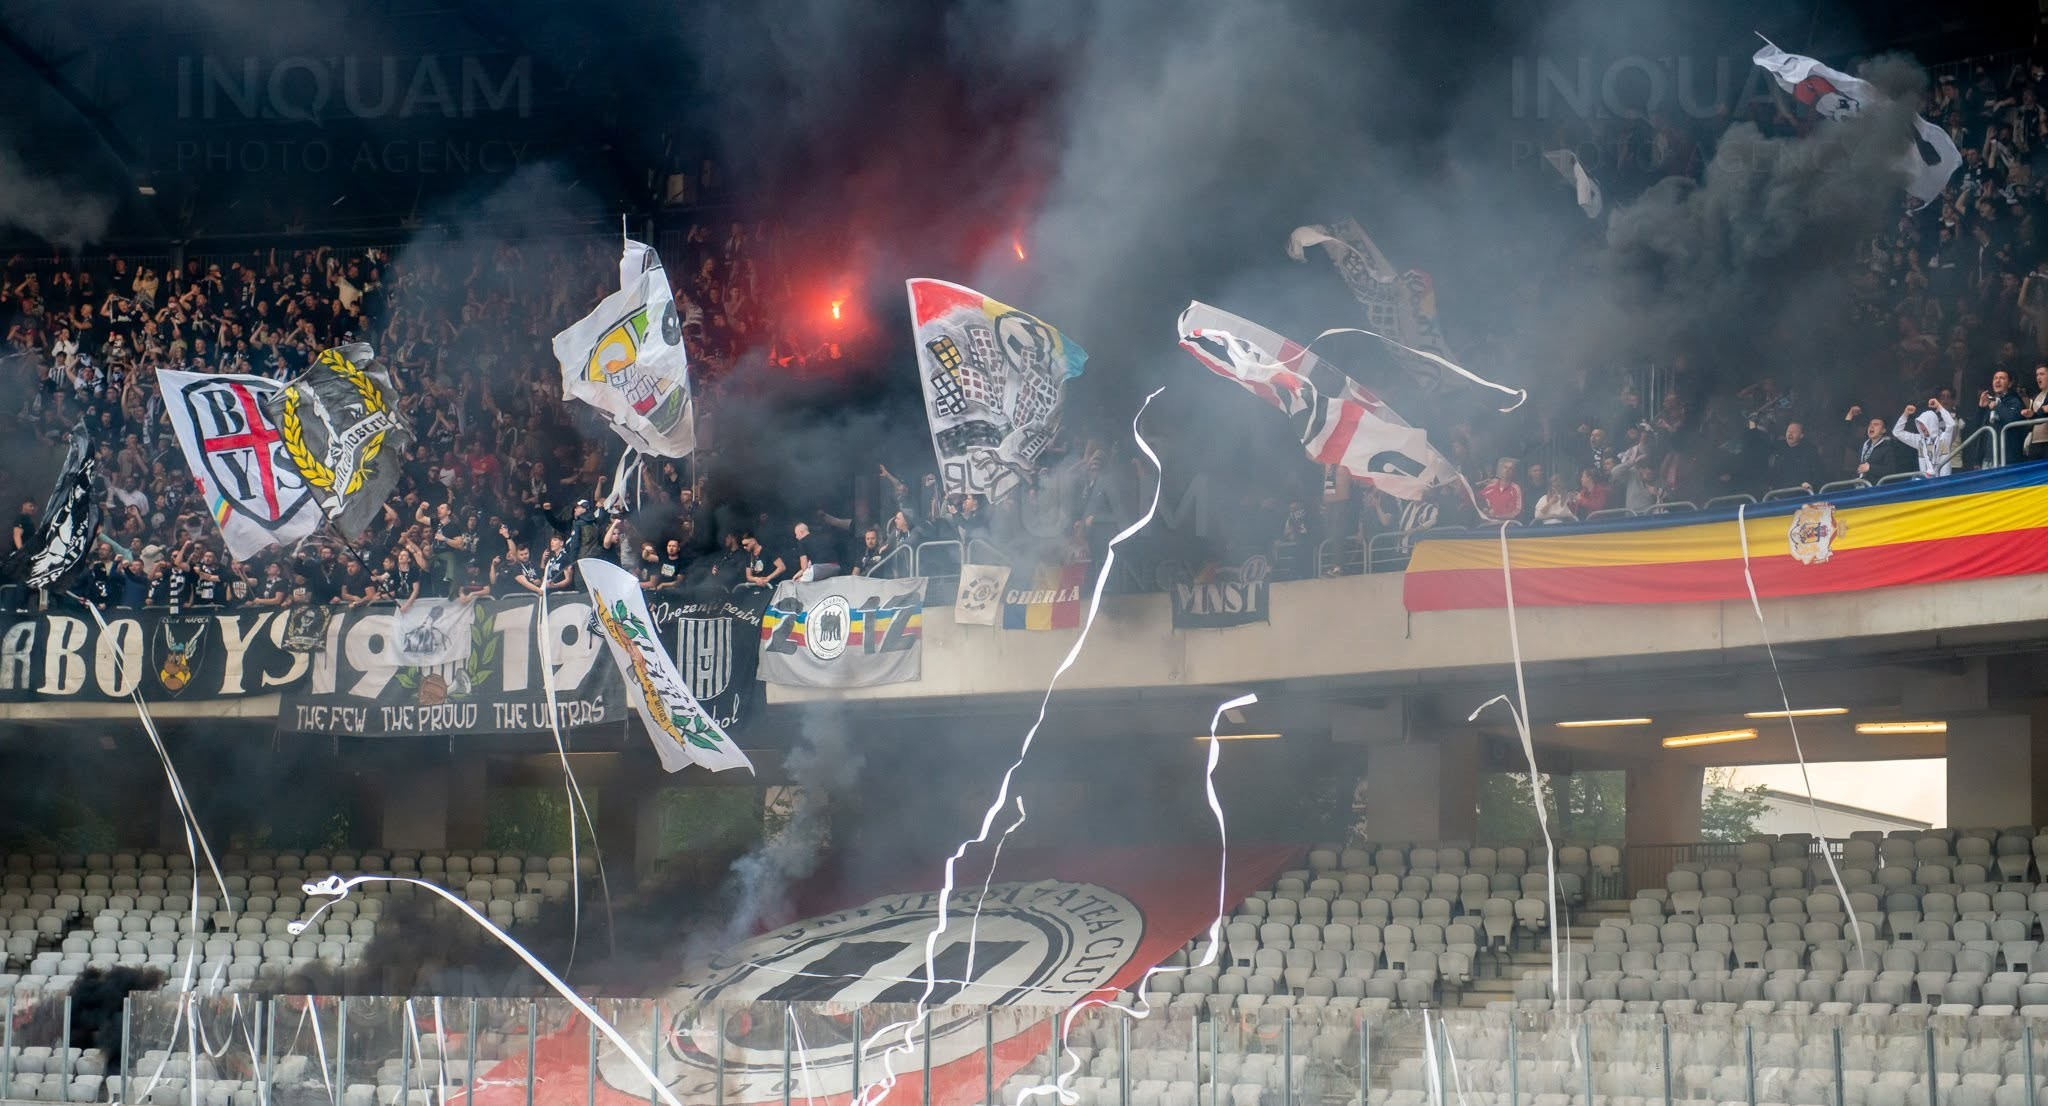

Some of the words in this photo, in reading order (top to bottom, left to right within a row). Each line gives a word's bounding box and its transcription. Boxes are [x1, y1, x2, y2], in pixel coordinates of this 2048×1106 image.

[296, 705, 328, 730] THE
[329, 706, 367, 732] FEW
[381, 705, 415, 732] THE
[418, 703, 477, 732] PROUD
[492, 702, 527, 729] THE
[532, 696, 605, 729] ULTRAS
